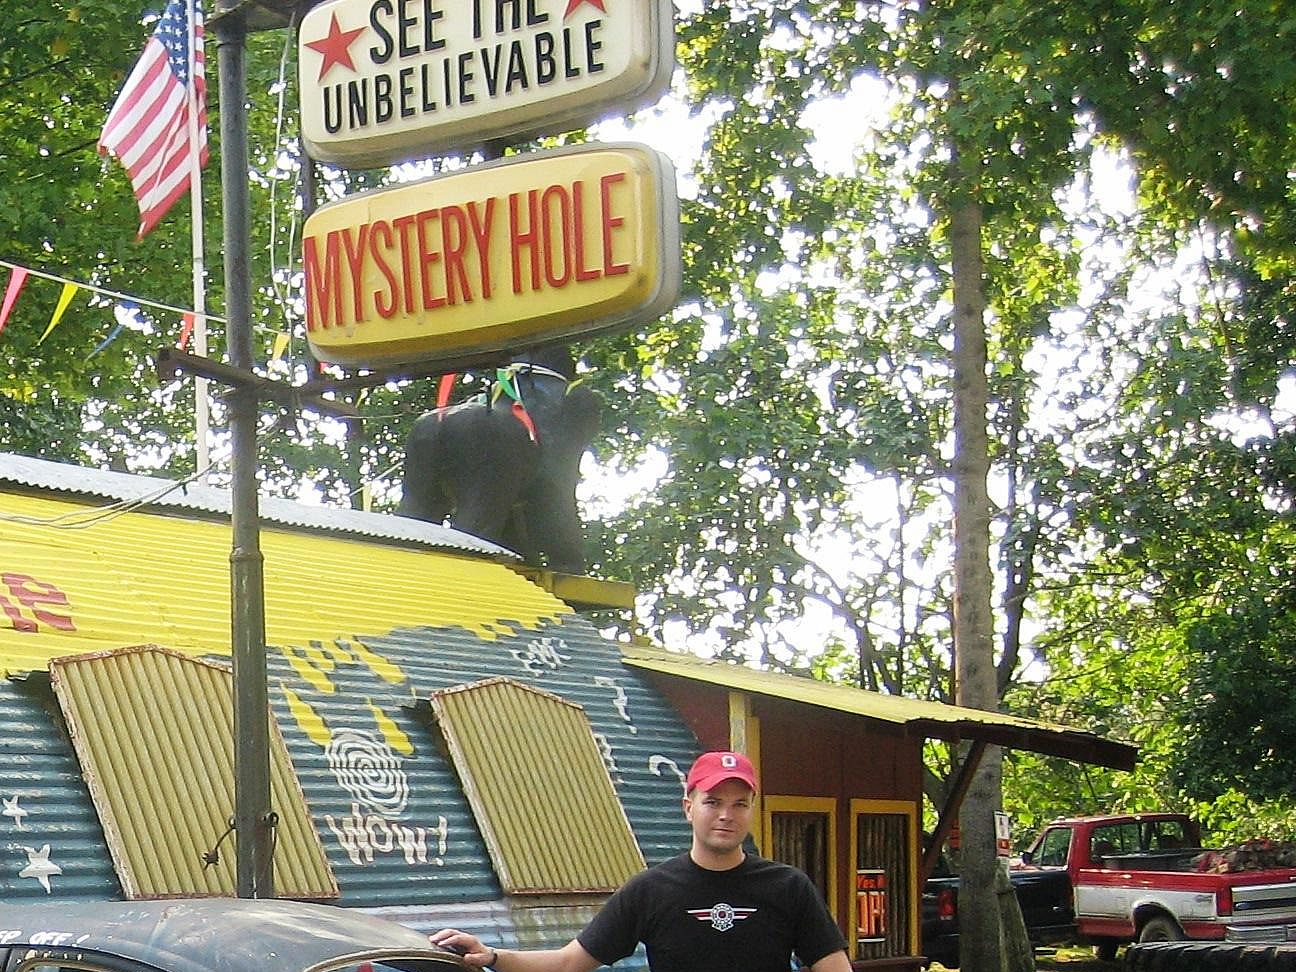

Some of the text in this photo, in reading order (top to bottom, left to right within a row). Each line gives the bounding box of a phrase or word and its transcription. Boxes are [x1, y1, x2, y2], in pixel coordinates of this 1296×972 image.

[322, 19, 605, 134] UNBELIEVABLE
[368, 0, 446, 64] SEE
[304, 172, 631, 332] MYSTERY HOLE
